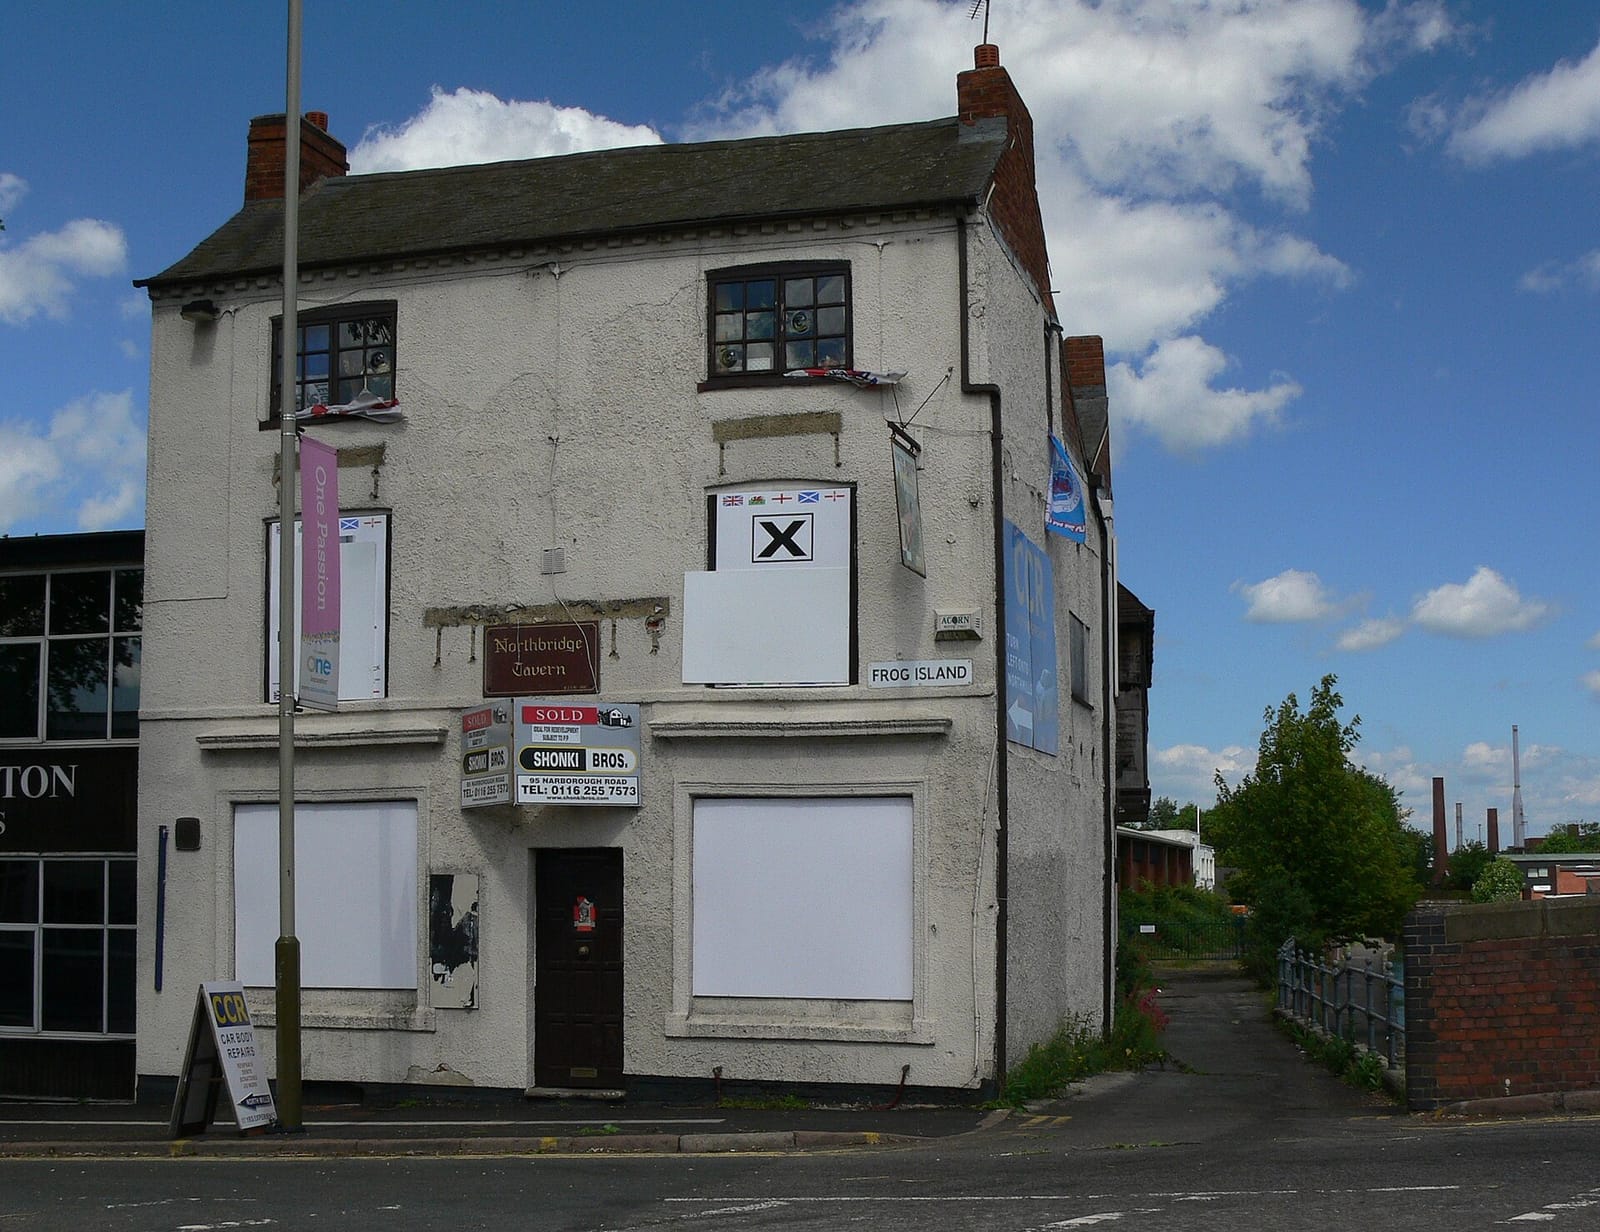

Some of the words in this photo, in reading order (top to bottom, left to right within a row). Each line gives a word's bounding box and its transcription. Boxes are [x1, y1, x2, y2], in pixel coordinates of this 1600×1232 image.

[315, 465, 327, 515] One
[316, 522, 329, 611] Passion
[941, 616, 970, 625] ACORN
[493, 636, 583, 654] Northbridge
[512, 662, 566, 677] Tavern
[872, 668, 910, 682] FROG
[915, 666, 967, 681] ISLAND
[536, 709, 583, 721] SOLD
[533, 751, 579, 768] SHONKI
[592, 753, 628, 768] BROS.
[542, 777, 602, 785] NARBOROUGH
[521, 785, 548, 795] TEL:
[551, 786, 580, 795] 0116
[584, 786, 605, 796] 255
[608, 786, 637, 796] 7573
[212, 994, 249, 1025] CCR
[220, 1033, 236, 1045] CAR
[235, 1031, 254, 1044] BODY
[227, 1046, 256, 1060] REPAIRS
